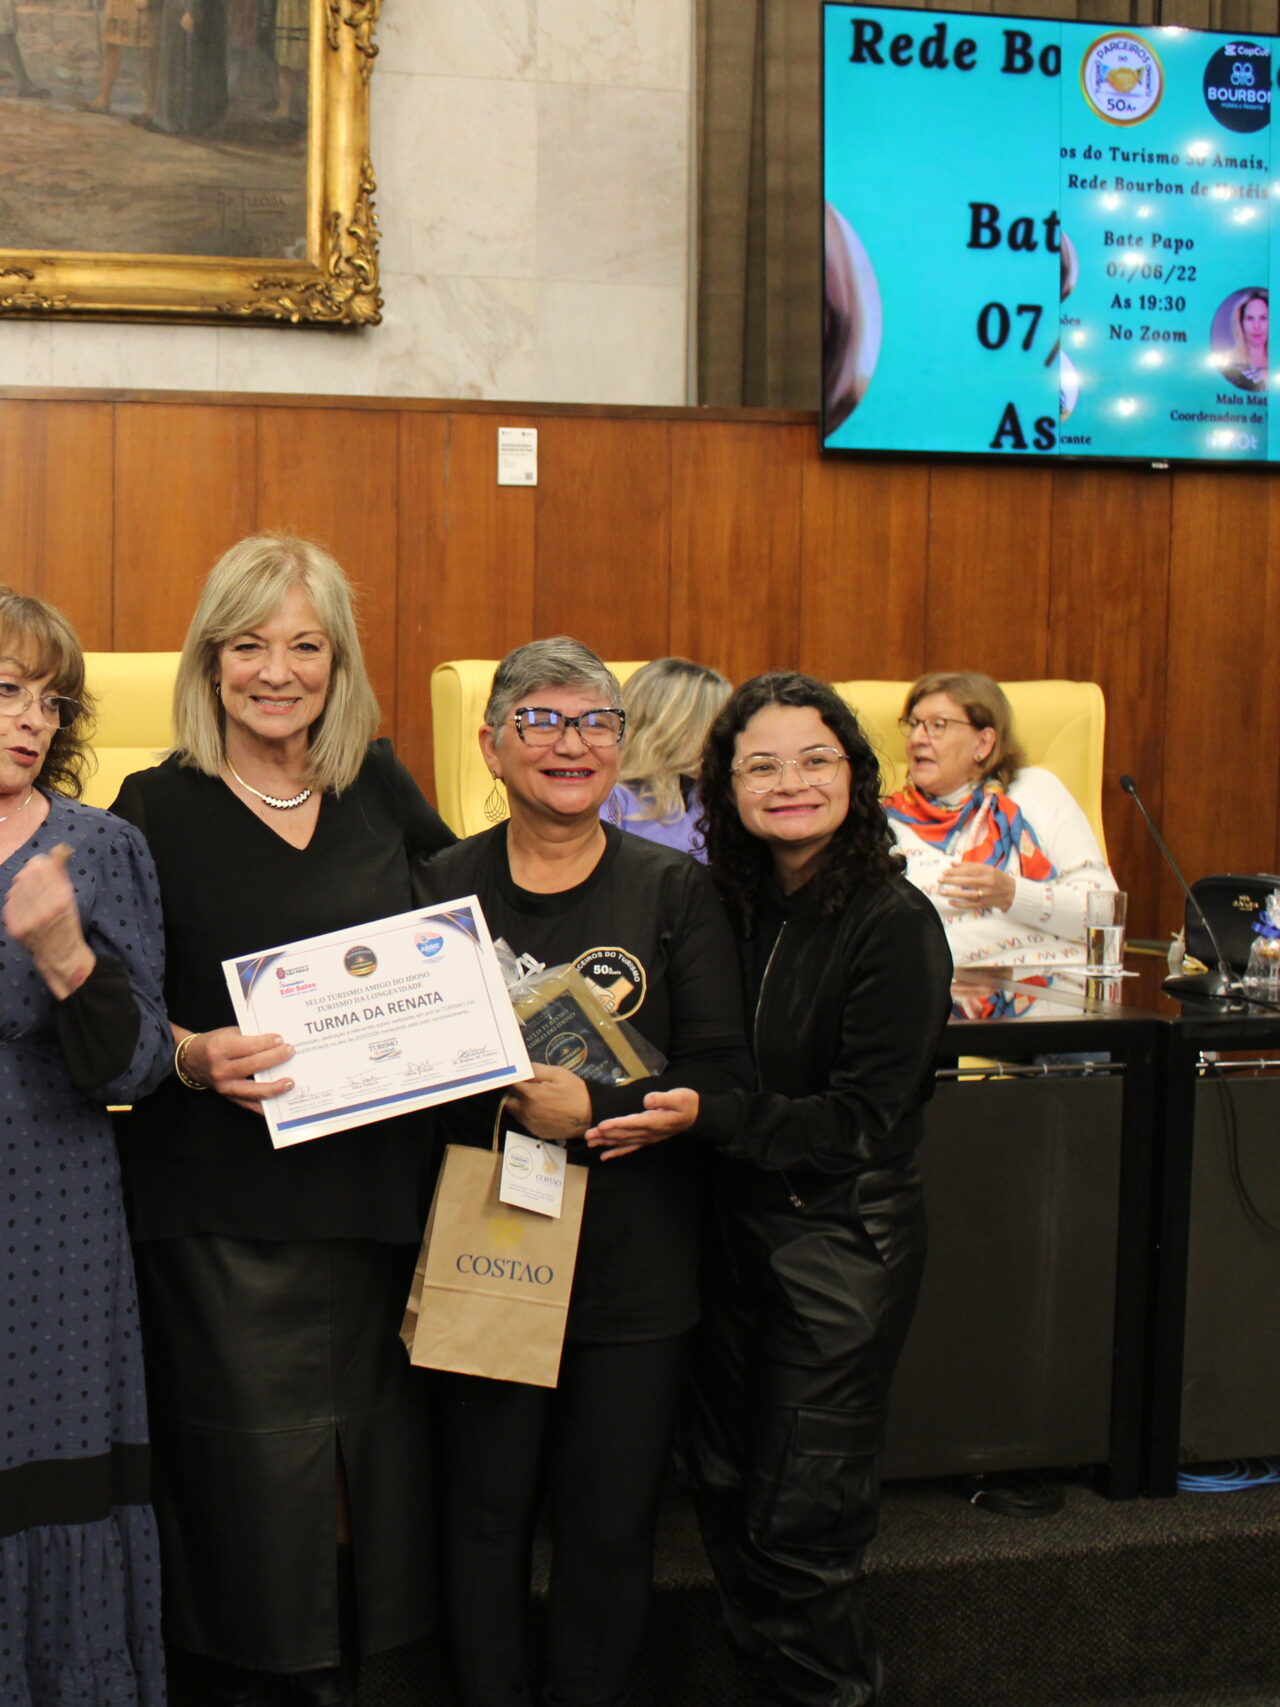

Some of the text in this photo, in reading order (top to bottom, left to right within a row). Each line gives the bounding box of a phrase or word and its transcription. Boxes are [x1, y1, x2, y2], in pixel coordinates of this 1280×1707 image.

[850, 18, 977, 71] Rede
[1096, 41, 1150, 63] PARCEIROS
[1083, 145, 1102, 160] do
[1109, 146, 1180, 165] Turismo
[1212, 153, 1268, 172] Amais,
[1068, 174, 1107, 191] Rede
[1114, 177, 1184, 195] Bourbon
[1191, 181, 1209, 196] de
[967, 201, 1060, 253] Bat
[1104, 230, 1194, 254] Bate Papo
[1106, 262, 1197, 284] 07/06/22
[1111, 294, 1186, 312] As 19:30
[1109, 325, 1187, 343] No Zoom
[1216, 394, 1243, 406] Malu
[989, 402, 1056, 450] As
[1170, 410, 1263, 424] Coordenadora de
[594, 965, 609, 975] 50
[618, 953, 640, 982] TURISMO
[317, 982, 423, 1013] TURISMO DA LONGEVIDADE
[327, 988, 363, 1001] TURISMO
[364, 980, 392, 993] AMIGO
[393, 977, 405, 986] DO
[406, 971, 430, 982] IDOSO
[304, 1011, 360, 1034] TURMA
[363, 1006, 385, 1021] DA
[387, 991, 444, 1015] RENATA
